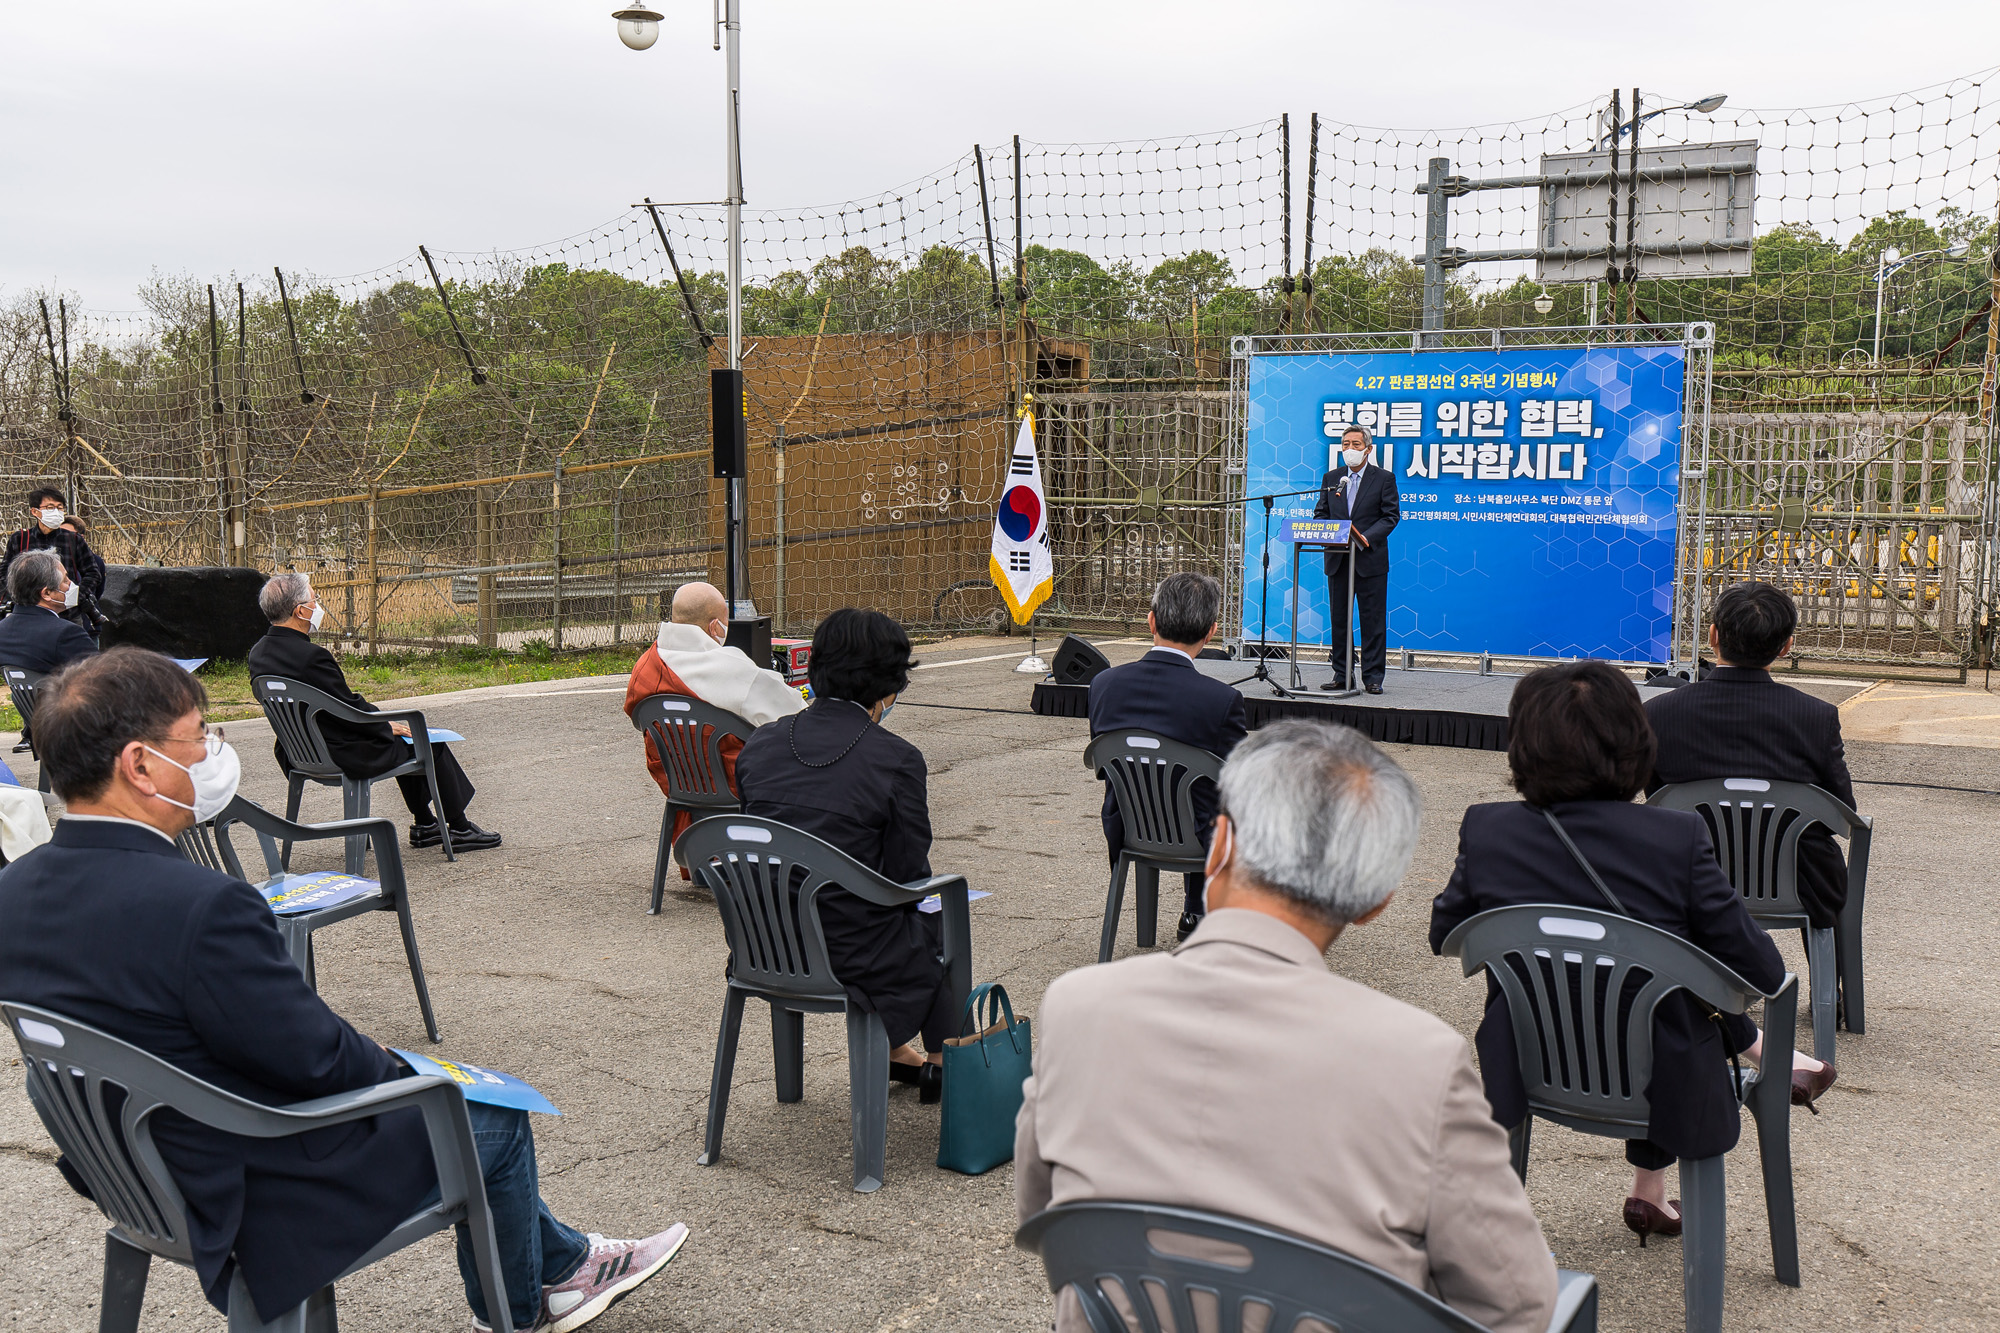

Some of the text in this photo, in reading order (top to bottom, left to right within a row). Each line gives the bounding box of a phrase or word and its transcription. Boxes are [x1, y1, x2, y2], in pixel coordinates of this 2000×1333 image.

[1355, 372, 1558, 390] 4.27 판문점선언 3주년 기념행사
[1323, 400, 1604, 439] 평화를 위한 협력,
[1406, 442, 1588, 480] 시작합시다
[1400, 493, 1417, 503] 오전
[1418, 493, 1438, 503] 9:30
[1454, 494, 1471, 504] 장소
[1560, 495, 1582, 505] DMZ
[1290, 508, 1316, 518] 민족화
[1399, 510, 1460, 521] 종교인평화회의,
